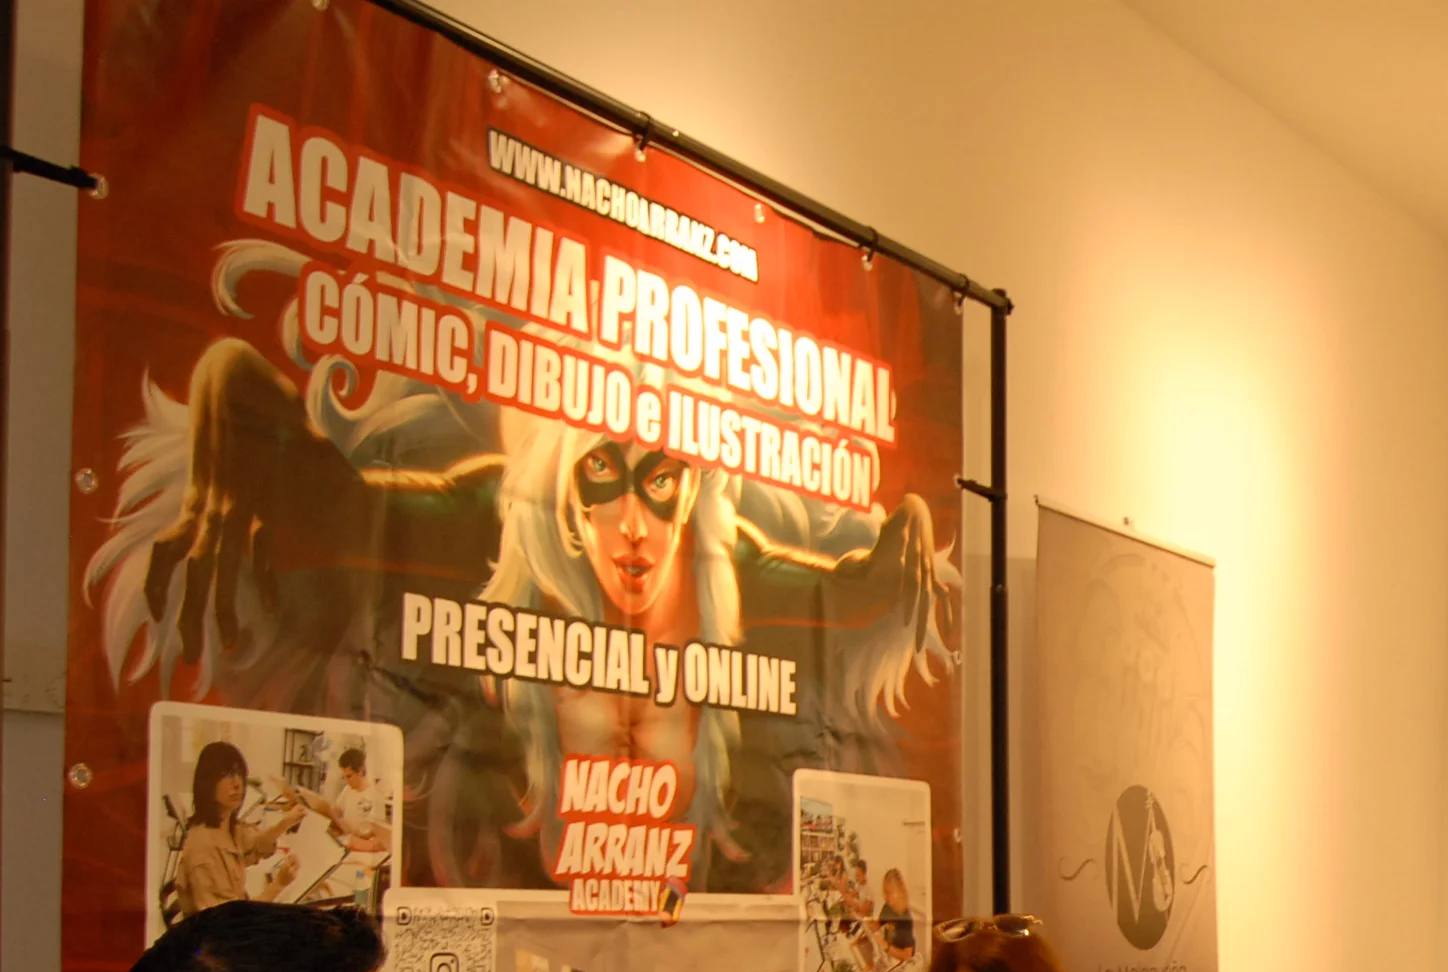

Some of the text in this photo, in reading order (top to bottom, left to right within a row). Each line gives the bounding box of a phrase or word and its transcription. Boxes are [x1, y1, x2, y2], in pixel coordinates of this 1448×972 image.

[488, 129, 759, 283] WWW.NACHOARRANZ.COM
[244, 114, 895, 443] ACADEMIA PROFESIONAL
[304, 264, 872, 507] CÓMIC, DIBUJO e ILUSTRACIÓN
[402, 592, 797, 715] PRESENCIAL y ONLINE
[555, 822, 694, 879] ARRANZ
[560, 759, 677, 819] NACHO
[570, 879, 660, 913] ACADEMY
